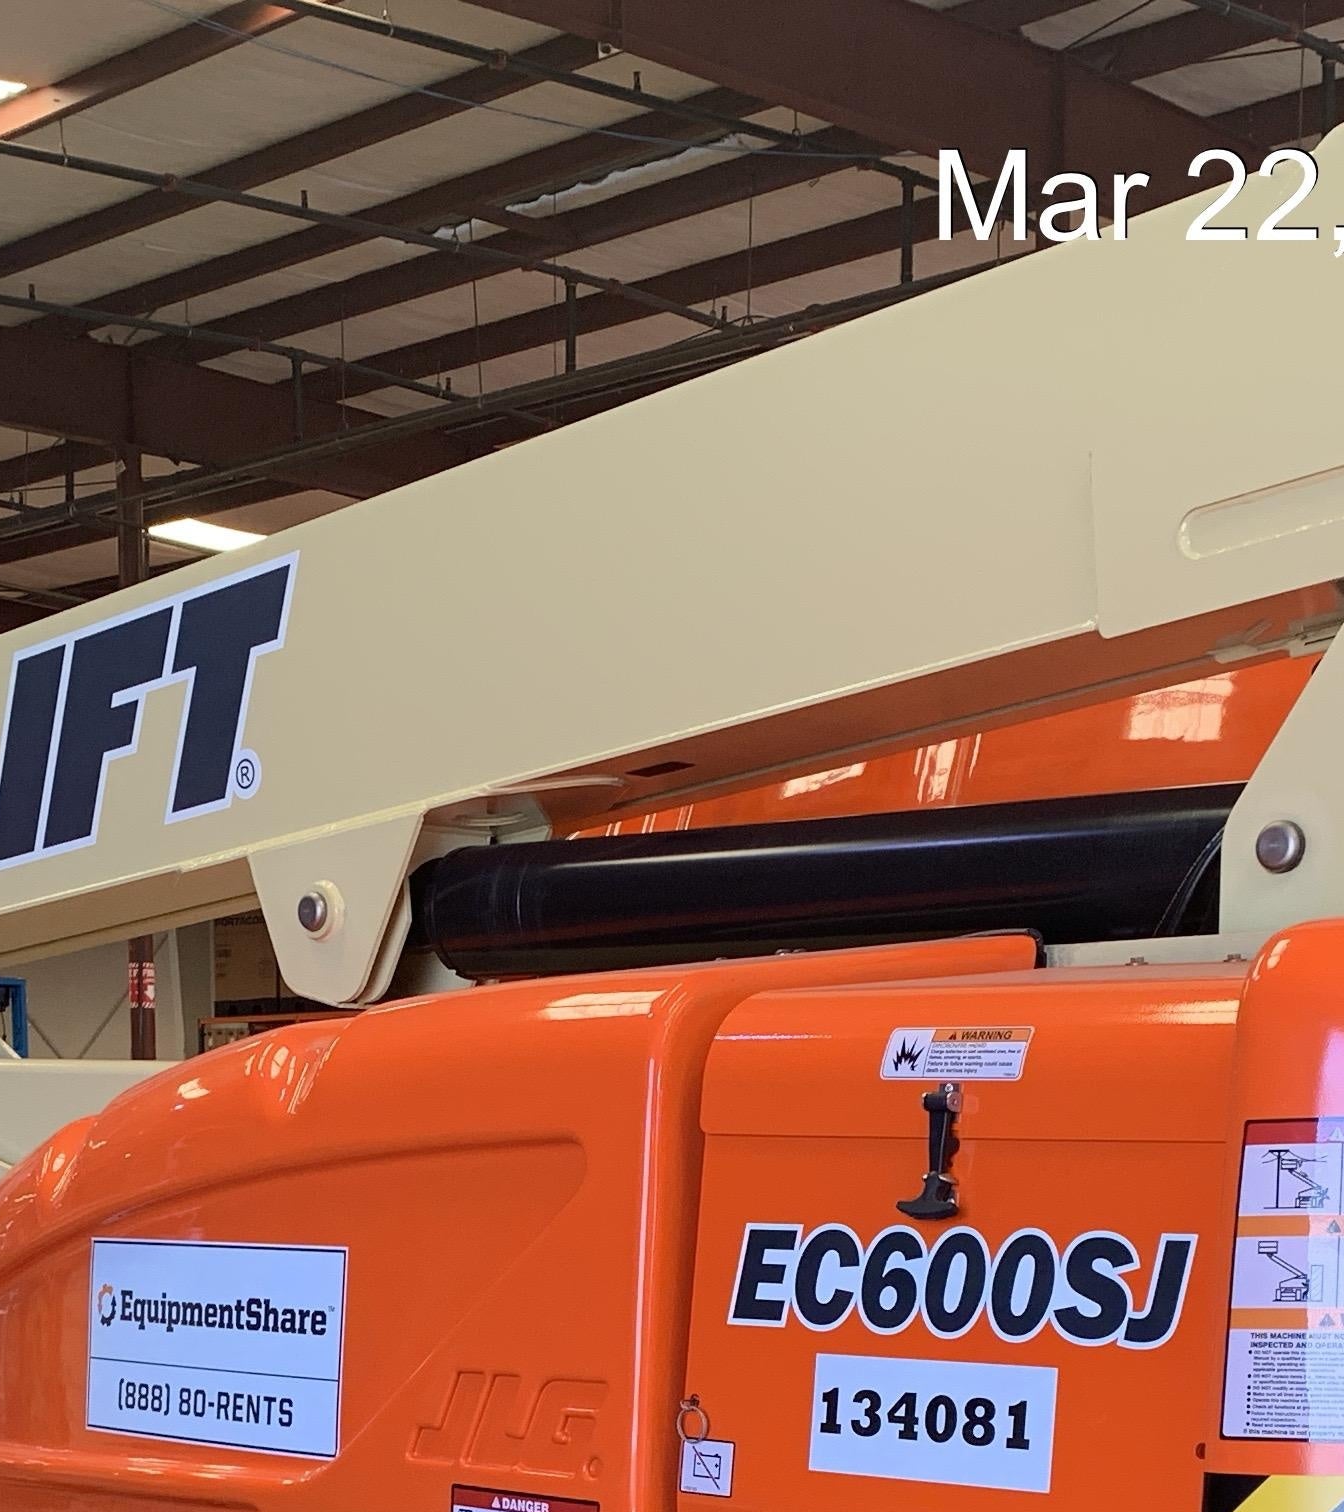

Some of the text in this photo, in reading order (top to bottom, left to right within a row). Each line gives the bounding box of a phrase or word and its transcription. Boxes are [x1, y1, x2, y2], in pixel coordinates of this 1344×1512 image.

[961, 1030, 1013, 1041] WARNING
[729, 1226, 1195, 1347] EC600SJ
[1250, 1332, 1269, 1340] THIS
[1270, 1332, 1306, 1340] MACHINE
[1250, 1341, 1294, 1349] INSPECTED
[1295, 1342, 1313, 1350] AND
[118, 1378, 294, 1428] (888) 80-RENTS
[819, 1387, 1031, 1451] 134081
